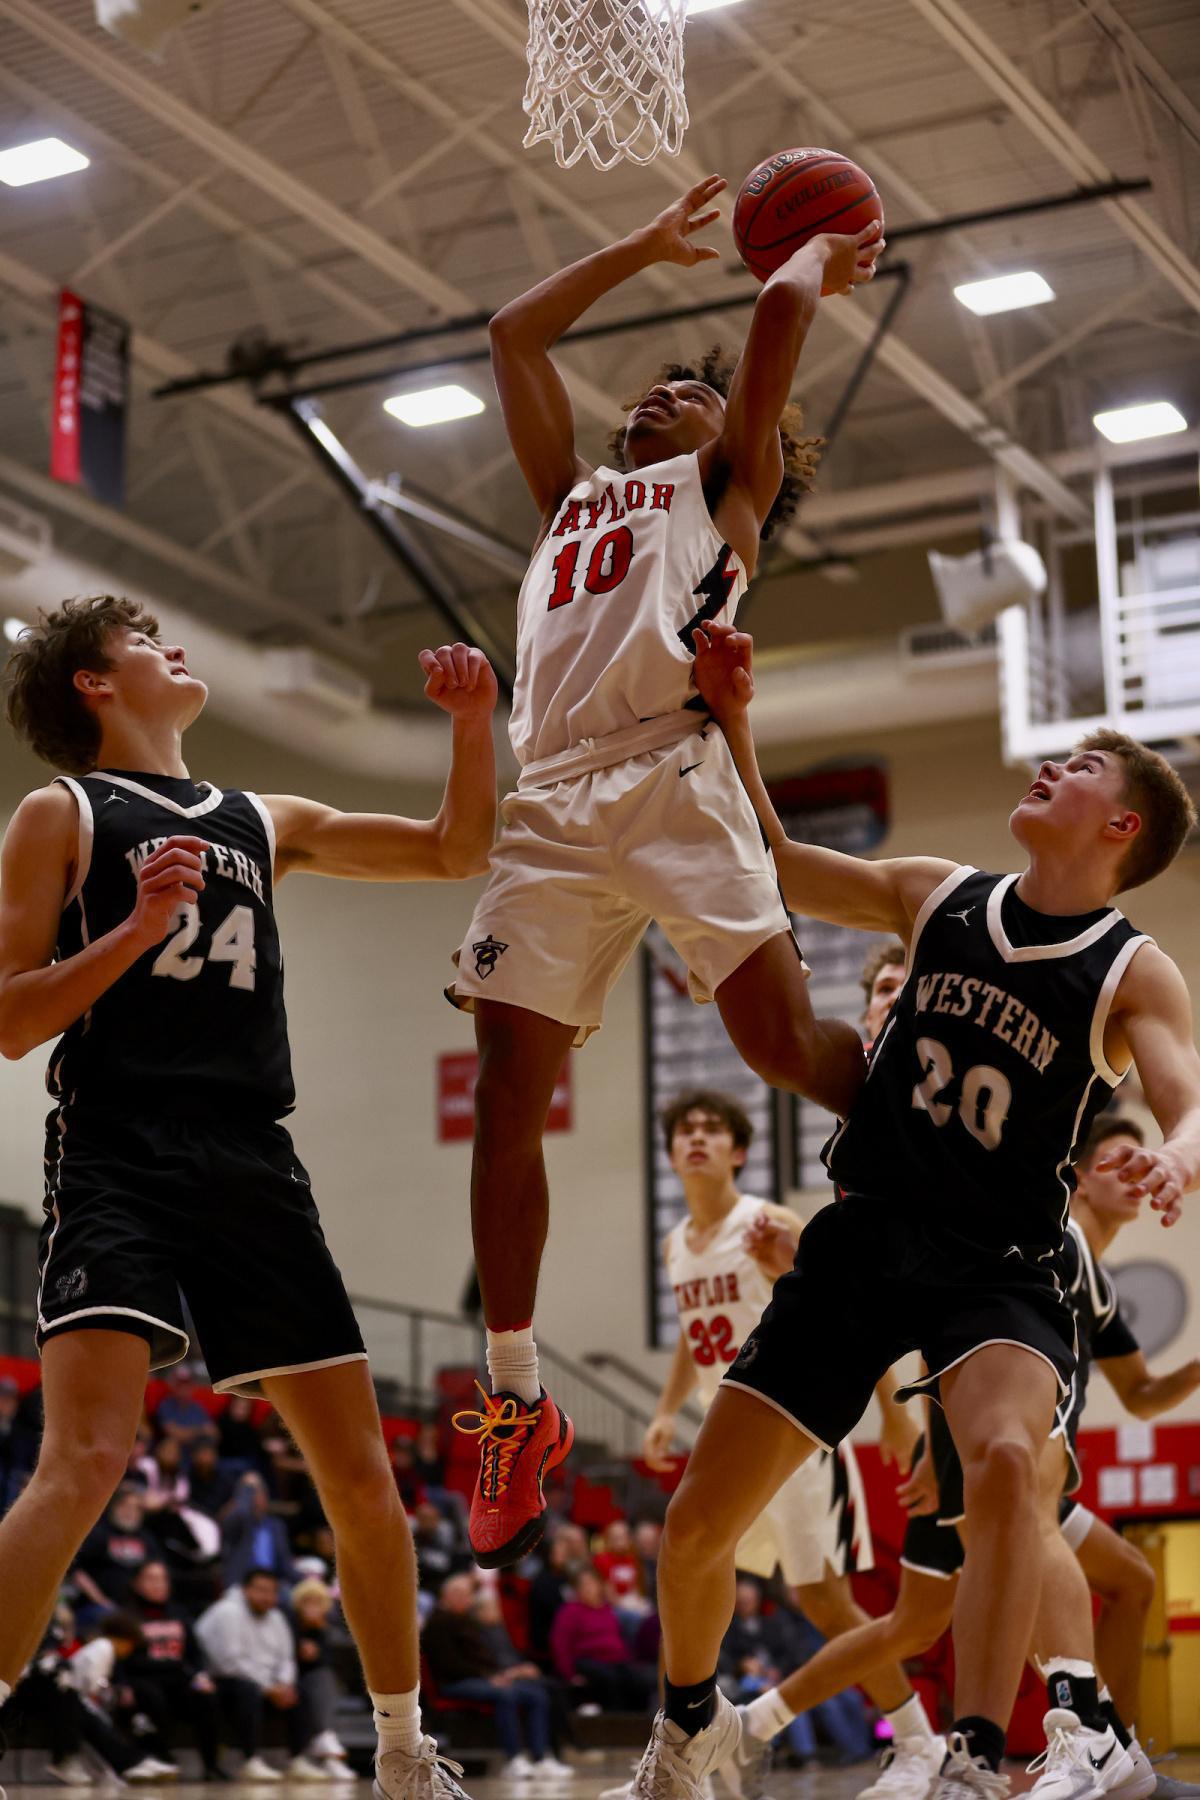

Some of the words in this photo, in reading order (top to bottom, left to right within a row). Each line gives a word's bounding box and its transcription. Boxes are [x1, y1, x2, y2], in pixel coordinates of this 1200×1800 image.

[776, 170, 857, 220] EVOLUTION
[550, 480, 675, 537] AYLOR
[547, 525, 635, 611] 10
[125, 836, 266, 906] WERN
[151, 901, 257, 992] 24
[915, 973, 1060, 1075] WESTERN
[911, 1037, 1013, 1151] 20
[674, 1272, 741, 1312] TAYLOR
[689, 1314, 739, 1367] 32
